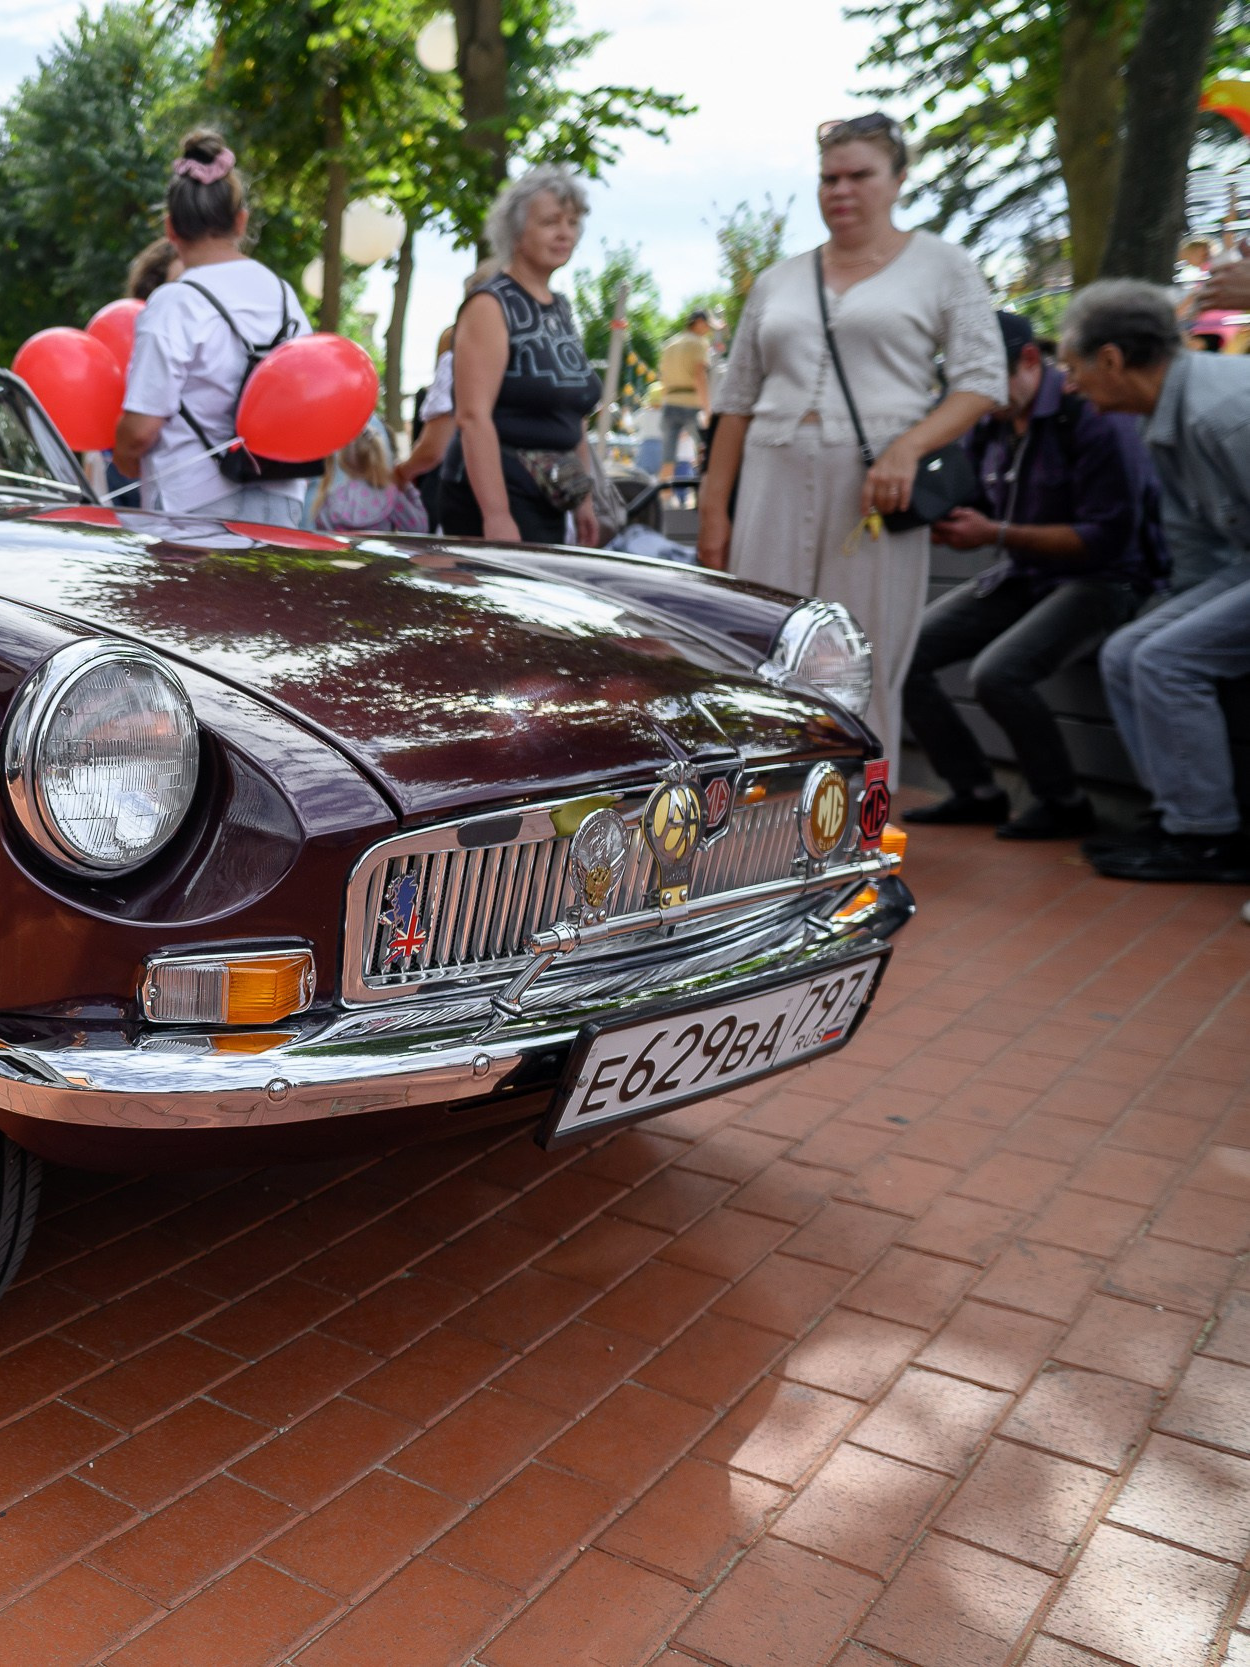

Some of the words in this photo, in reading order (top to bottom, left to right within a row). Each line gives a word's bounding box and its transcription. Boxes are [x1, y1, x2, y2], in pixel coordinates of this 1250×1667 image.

[706, 780, 730, 826] MG
[817, 784, 844, 838] MG
[863, 785, 889, 837] MG
[792, 969, 867, 1037] 797
[792, 1027, 825, 1053] RUS
